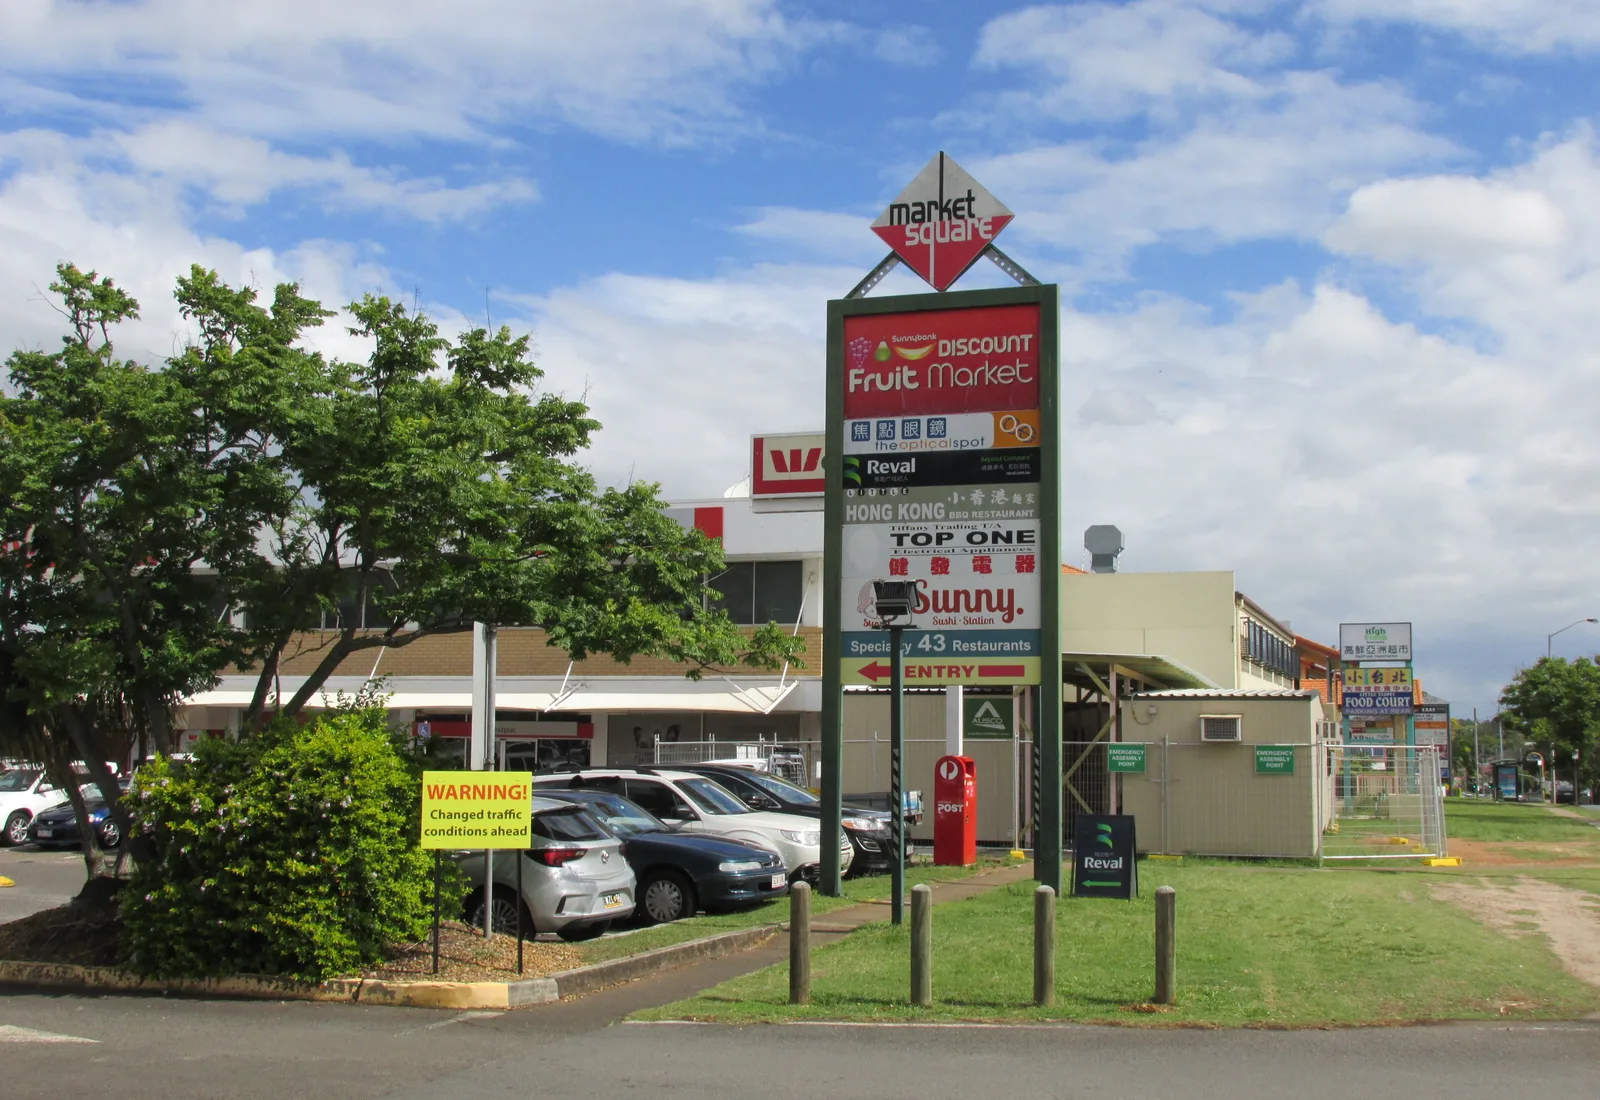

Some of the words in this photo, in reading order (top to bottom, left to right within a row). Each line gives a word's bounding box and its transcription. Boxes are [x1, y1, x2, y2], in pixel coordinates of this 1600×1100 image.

[889, 189, 975, 226] market
[905, 217, 993, 247] square
[891, 333, 937, 343] Sunnybank
[937, 334, 1034, 357] DISCOUNT
[849, 365, 920, 393] Fruit
[928, 358, 1034, 388] Market
[852, 418, 947, 440] 焦點眼鏡
[867, 457, 916, 475] Reval
[847, 487, 909, 497] LITTLE
[846, 503, 893, 521] HONG
[898, 502, 945, 521] KONG
[948, 511, 969, 519] BBQ
[971, 509, 1035, 518] RESTAURANT
[934, 523, 978, 531] Trading
[889, 532, 954, 547] TOP
[966, 530, 1035, 545] ONE
[960, 546, 1032, 554] Appliances
[932, 616, 957, 626] Sushi
[963, 615, 995, 626] Station
[917, 634, 947, 652] 43
[952, 639, 1032, 651] Restaurants
[904, 665, 976, 678] ENTRY
[1348, 669, 1408, 684] 小台北
[1345, 697, 1373, 707] FOOD
[1376, 696, 1411, 707] COURT
[427, 784, 528, 800] WARNING!
[937, 803, 964, 812] POST
[430, 809, 484, 822] Changed
[487, 809, 522, 820] traffic
[424, 826, 488, 836] conditions
[491, 826, 528, 836] ahead
[1084, 857, 1123, 869] Reval
